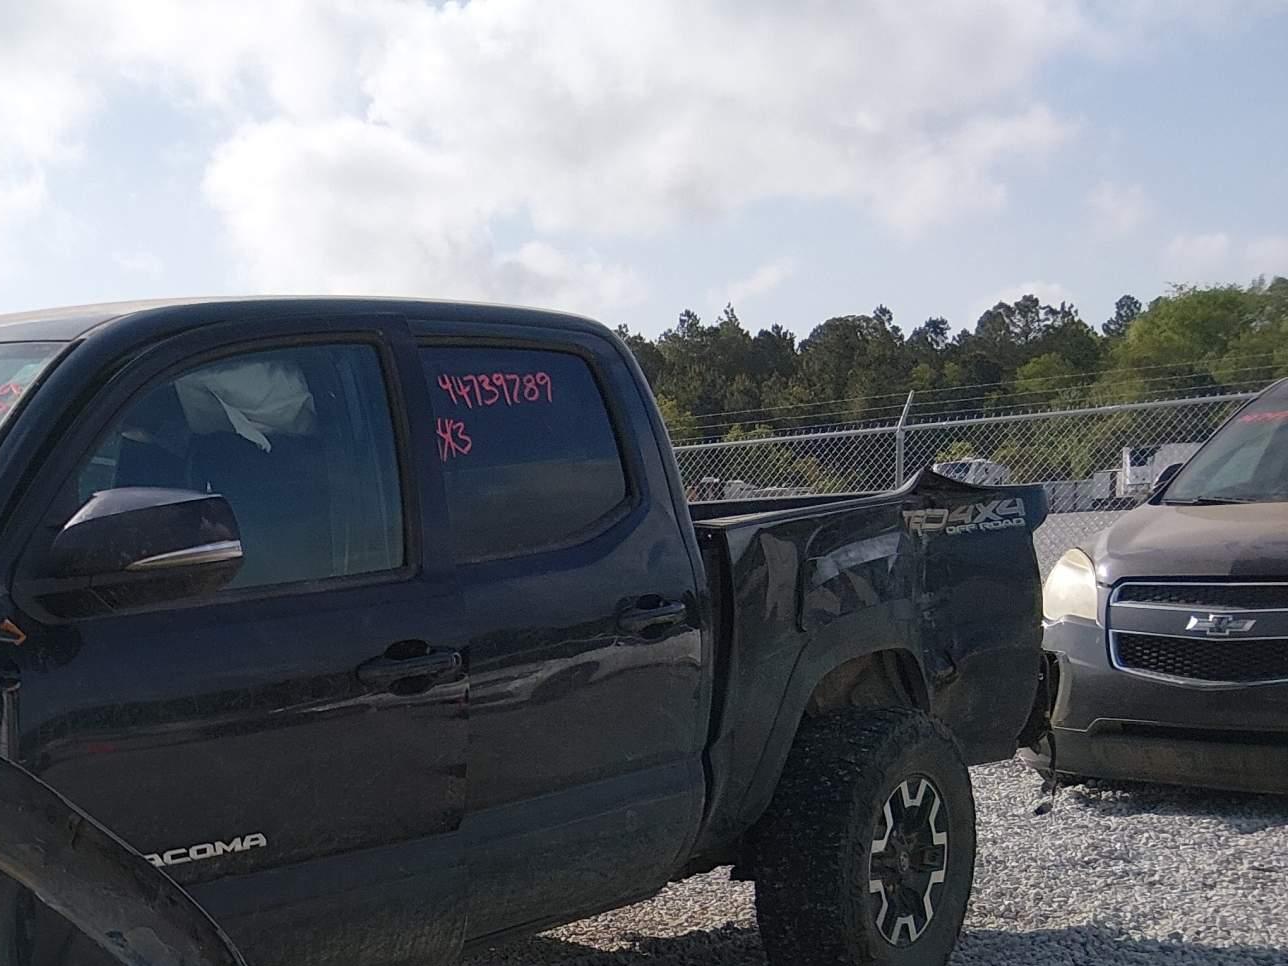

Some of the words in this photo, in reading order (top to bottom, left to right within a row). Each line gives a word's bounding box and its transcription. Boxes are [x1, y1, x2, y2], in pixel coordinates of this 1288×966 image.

[438, 372, 552, 408] 44739789
[946, 523, 977, 535] OFF
[979, 517, 1026, 532] ROAD
[143, 832, 267, 868] ACOMA
